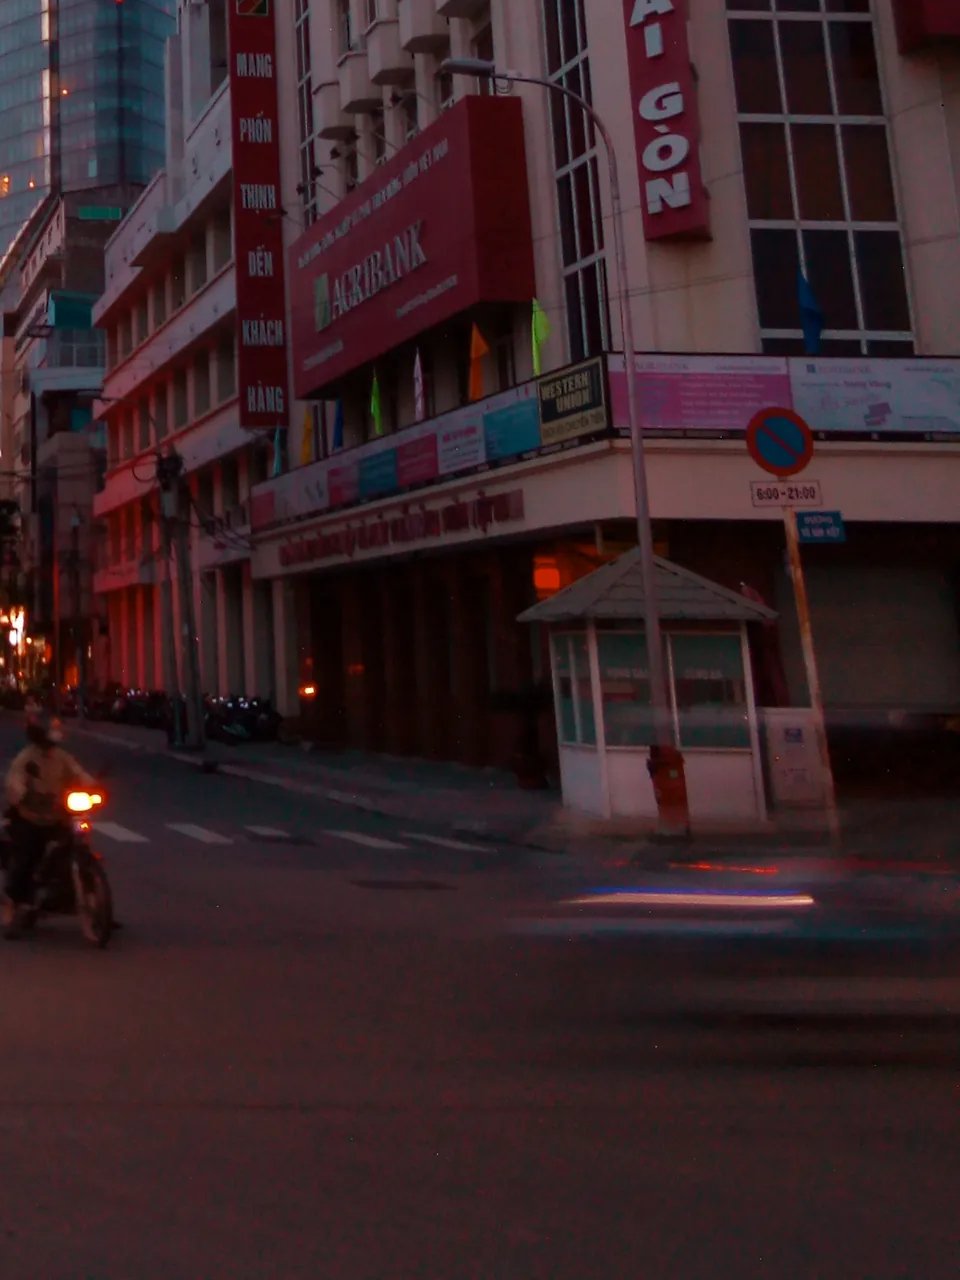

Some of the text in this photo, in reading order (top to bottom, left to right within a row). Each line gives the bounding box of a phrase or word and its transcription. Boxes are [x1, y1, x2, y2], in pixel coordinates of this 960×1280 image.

[236, 52, 272, 78] MANG
[638, 81, 690, 214] GÒN
[240, 183, 276, 215] THỊNH
[332, 218, 428, 320] AGRIBANK
[242, 312, 284, 347] KHÁCH
[248, 380, 285, 413] HÀNG
[540, 370, 591, 401] WESTERN
[556, 387, 591, 413] UNION
